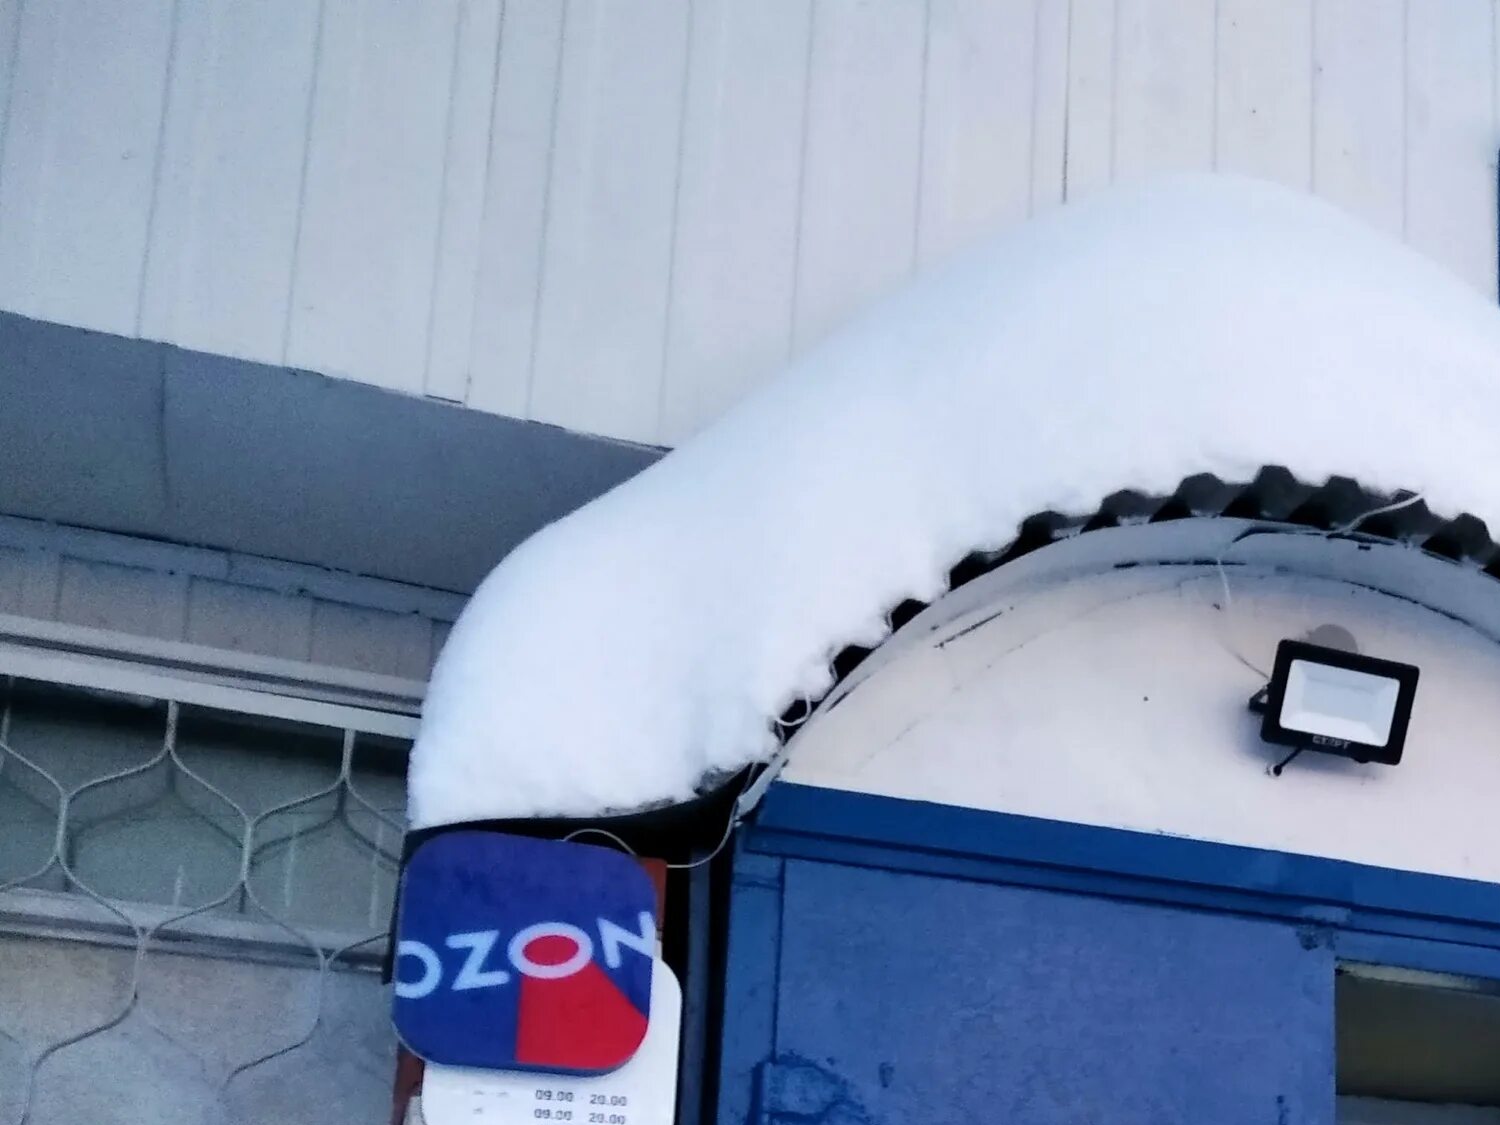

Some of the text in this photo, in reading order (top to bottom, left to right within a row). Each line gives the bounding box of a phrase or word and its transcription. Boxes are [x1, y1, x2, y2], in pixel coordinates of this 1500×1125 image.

[394, 911, 657, 1000] OZON
[535, 1089, 628, 1106] 09.00 20.00
[588, 1112, 626, 1125] 20.00
